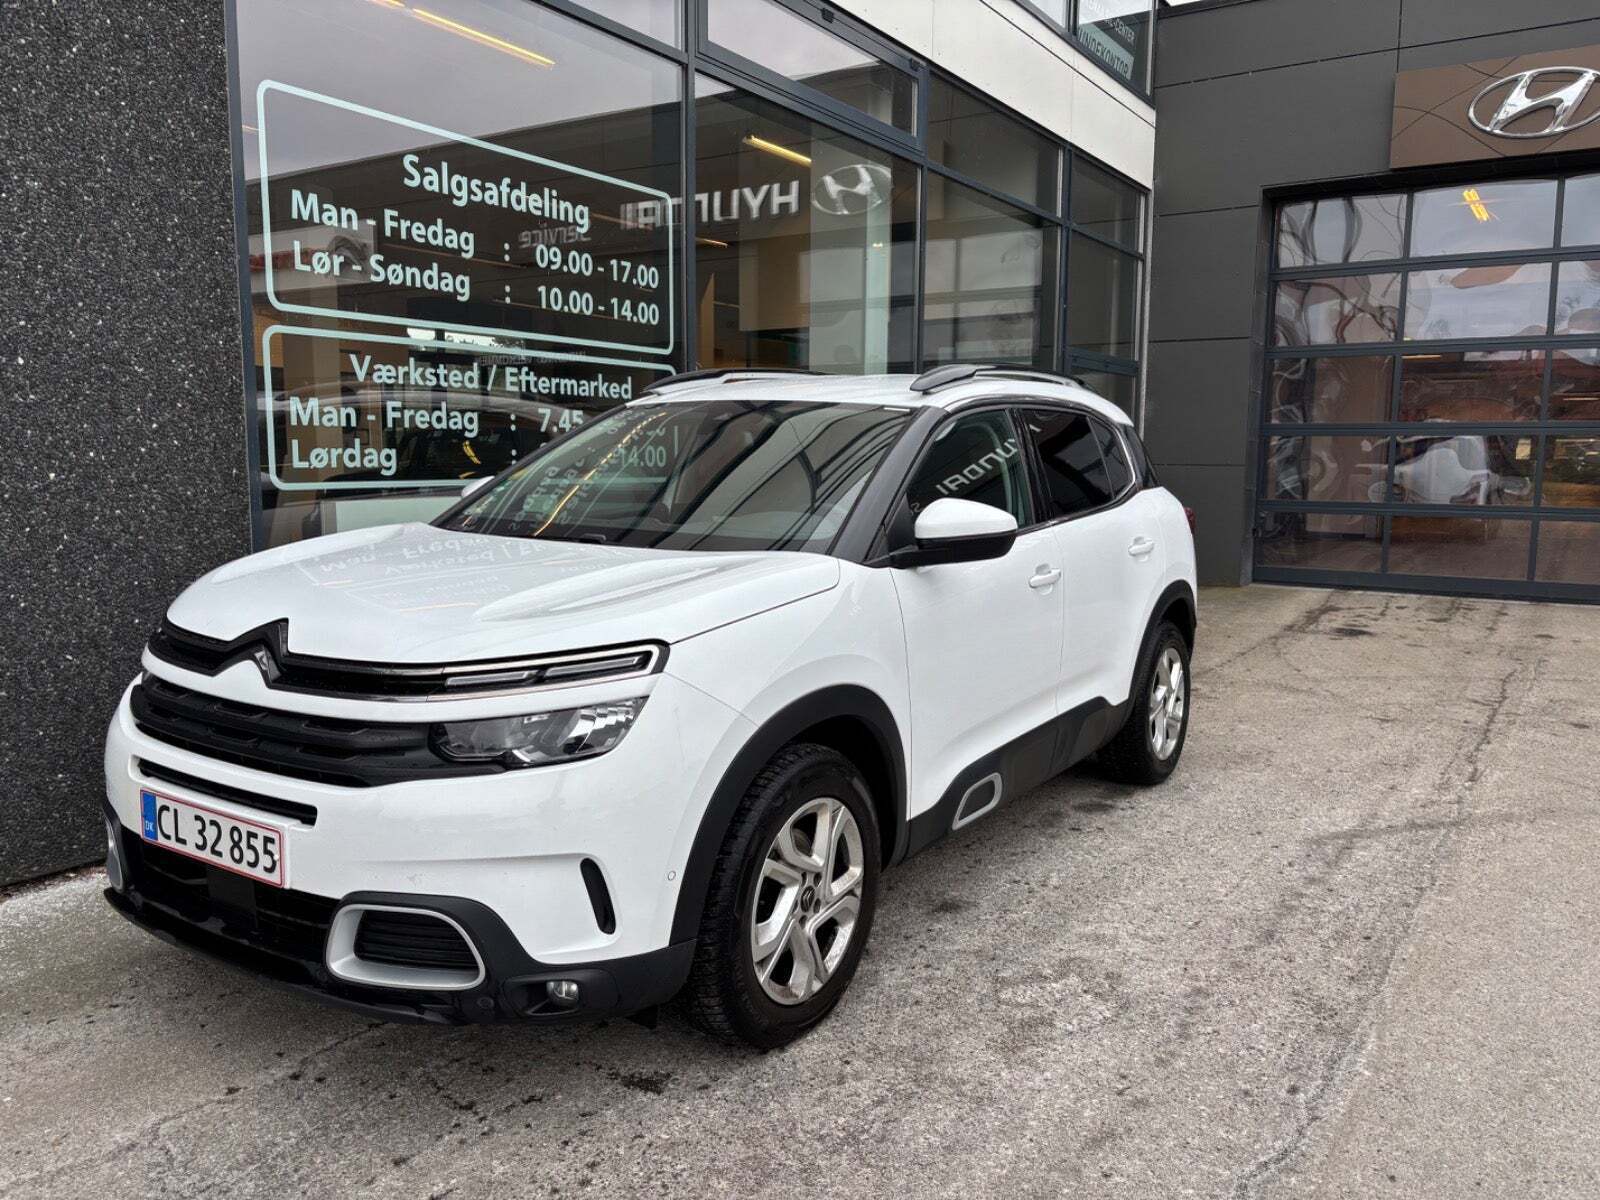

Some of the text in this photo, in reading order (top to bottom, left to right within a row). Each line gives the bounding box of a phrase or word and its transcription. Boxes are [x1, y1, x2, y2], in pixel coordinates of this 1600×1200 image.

[403, 154, 590, 233] Salgsafdeling
[291, 189, 359, 231] Man
[384, 208, 475, 259] Fredag
[536, 244, 593, 276] 09.00
[610, 259, 659, 289] 17.00
[293, 240, 345, 276] Lør
[370, 254, 470, 301] Søndag
[538, 285, 594, 316] 10.00
[611, 297, 660, 326] 14.00
[350, 353, 479, 389] Værksted
[487, 364, 497, 391] /
[505, 367, 633, 400] Eftermarked
[289, 396, 357, 428] Man
[386, 401, 479, 438] Fredag
[538, 408, 584, 433] 7.45
[291, 438, 397, 476] Lørdag
[145, 820, 155, 833] DK
[158, 804, 278, 874] CL 32 855
